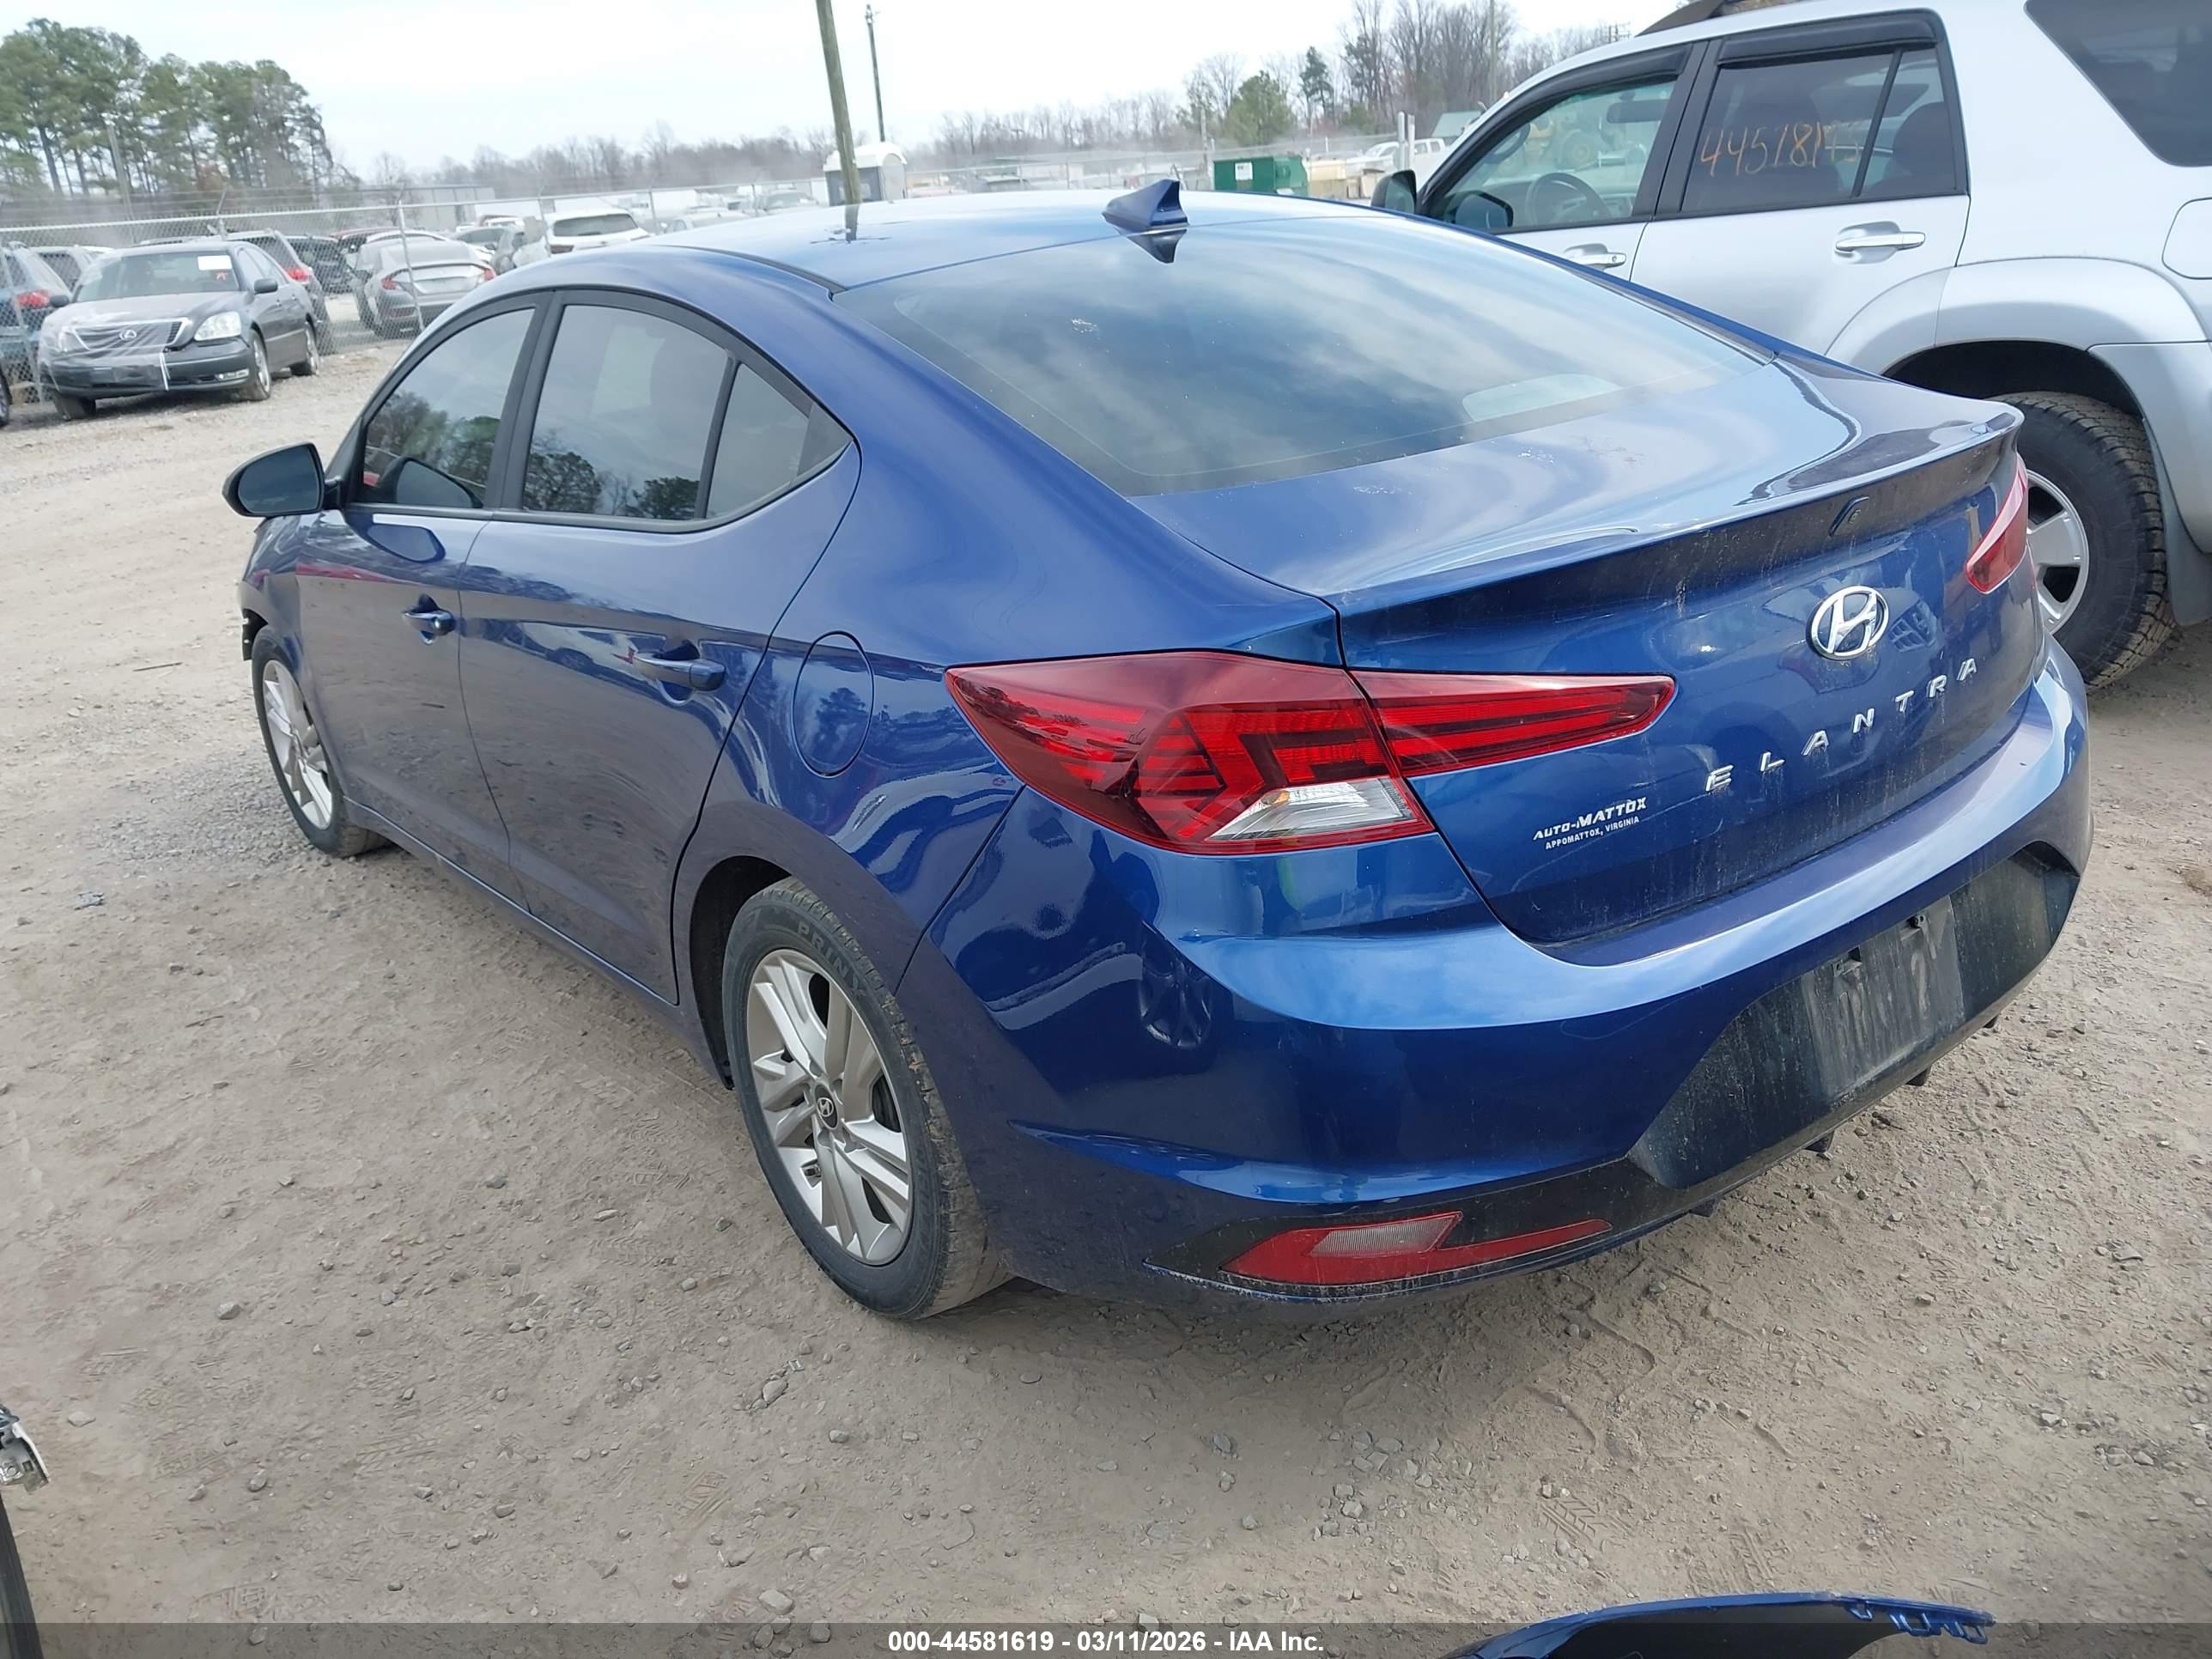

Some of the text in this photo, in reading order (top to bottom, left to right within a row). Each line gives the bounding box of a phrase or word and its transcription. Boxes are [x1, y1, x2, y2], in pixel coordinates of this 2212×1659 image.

[1705, 658, 1977, 792] ELANTRA
[1533, 797, 1647, 841] AUTO-MATTOX
[1545, 816, 1640, 850] APPOMATTOX, VIRGINIA
